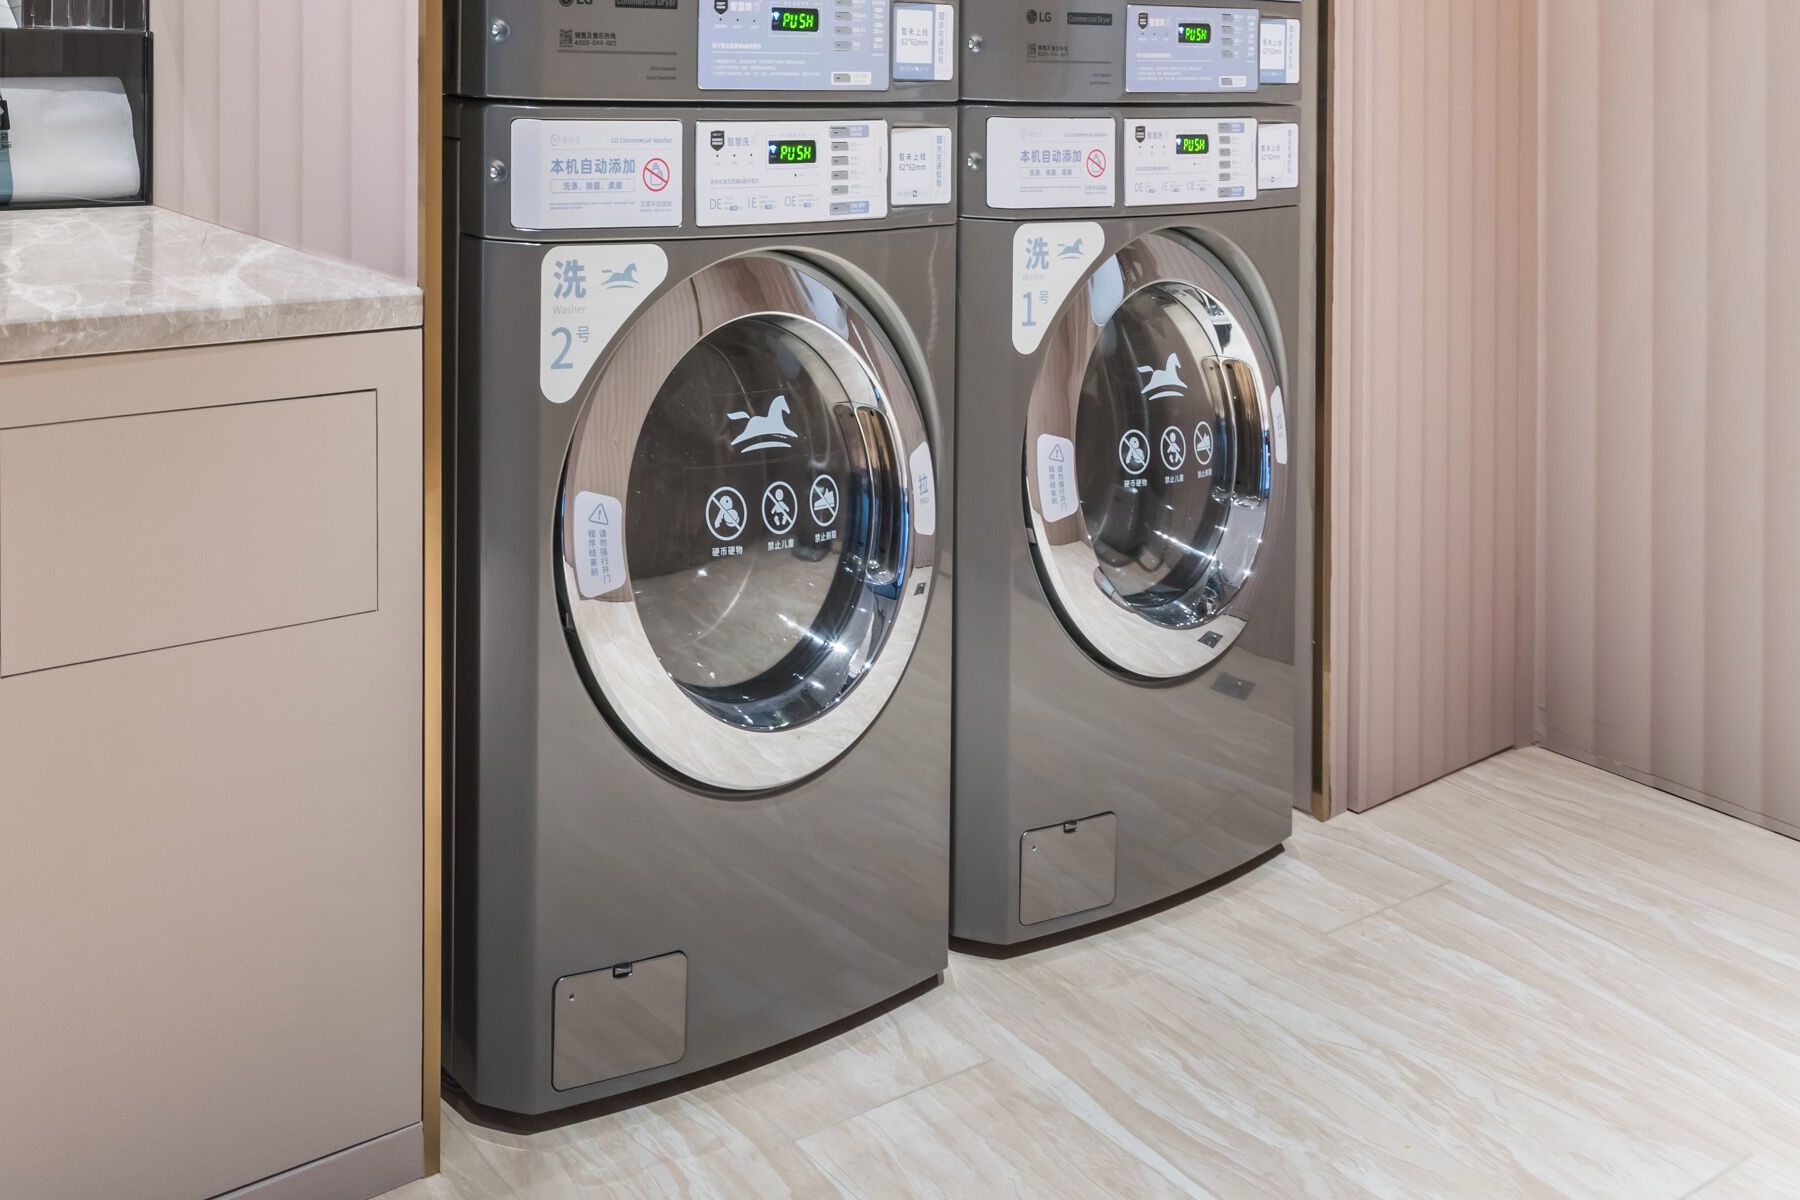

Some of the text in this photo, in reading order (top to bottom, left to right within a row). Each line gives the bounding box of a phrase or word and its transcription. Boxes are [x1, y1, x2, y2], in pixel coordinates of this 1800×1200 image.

[782, 12, 814, 29] PUSH
[1039, 12, 1052, 22] LG
[1185, 28, 1207, 41] PUSH
[1183, 139, 1205, 151] PUSH
[780, 145, 812, 161] PUSH
[1020, 150, 1081, 163] 本机自动添加
[550, 158, 636, 175] 本机自动添加
[1025, 237, 1049, 270] 洗
[553, 259, 586, 299] 洗
[553, 304, 586, 315] Washer
[711, 545, 744, 557] 硬币硬物
[767, 539, 794, 551] 禁止儿童
